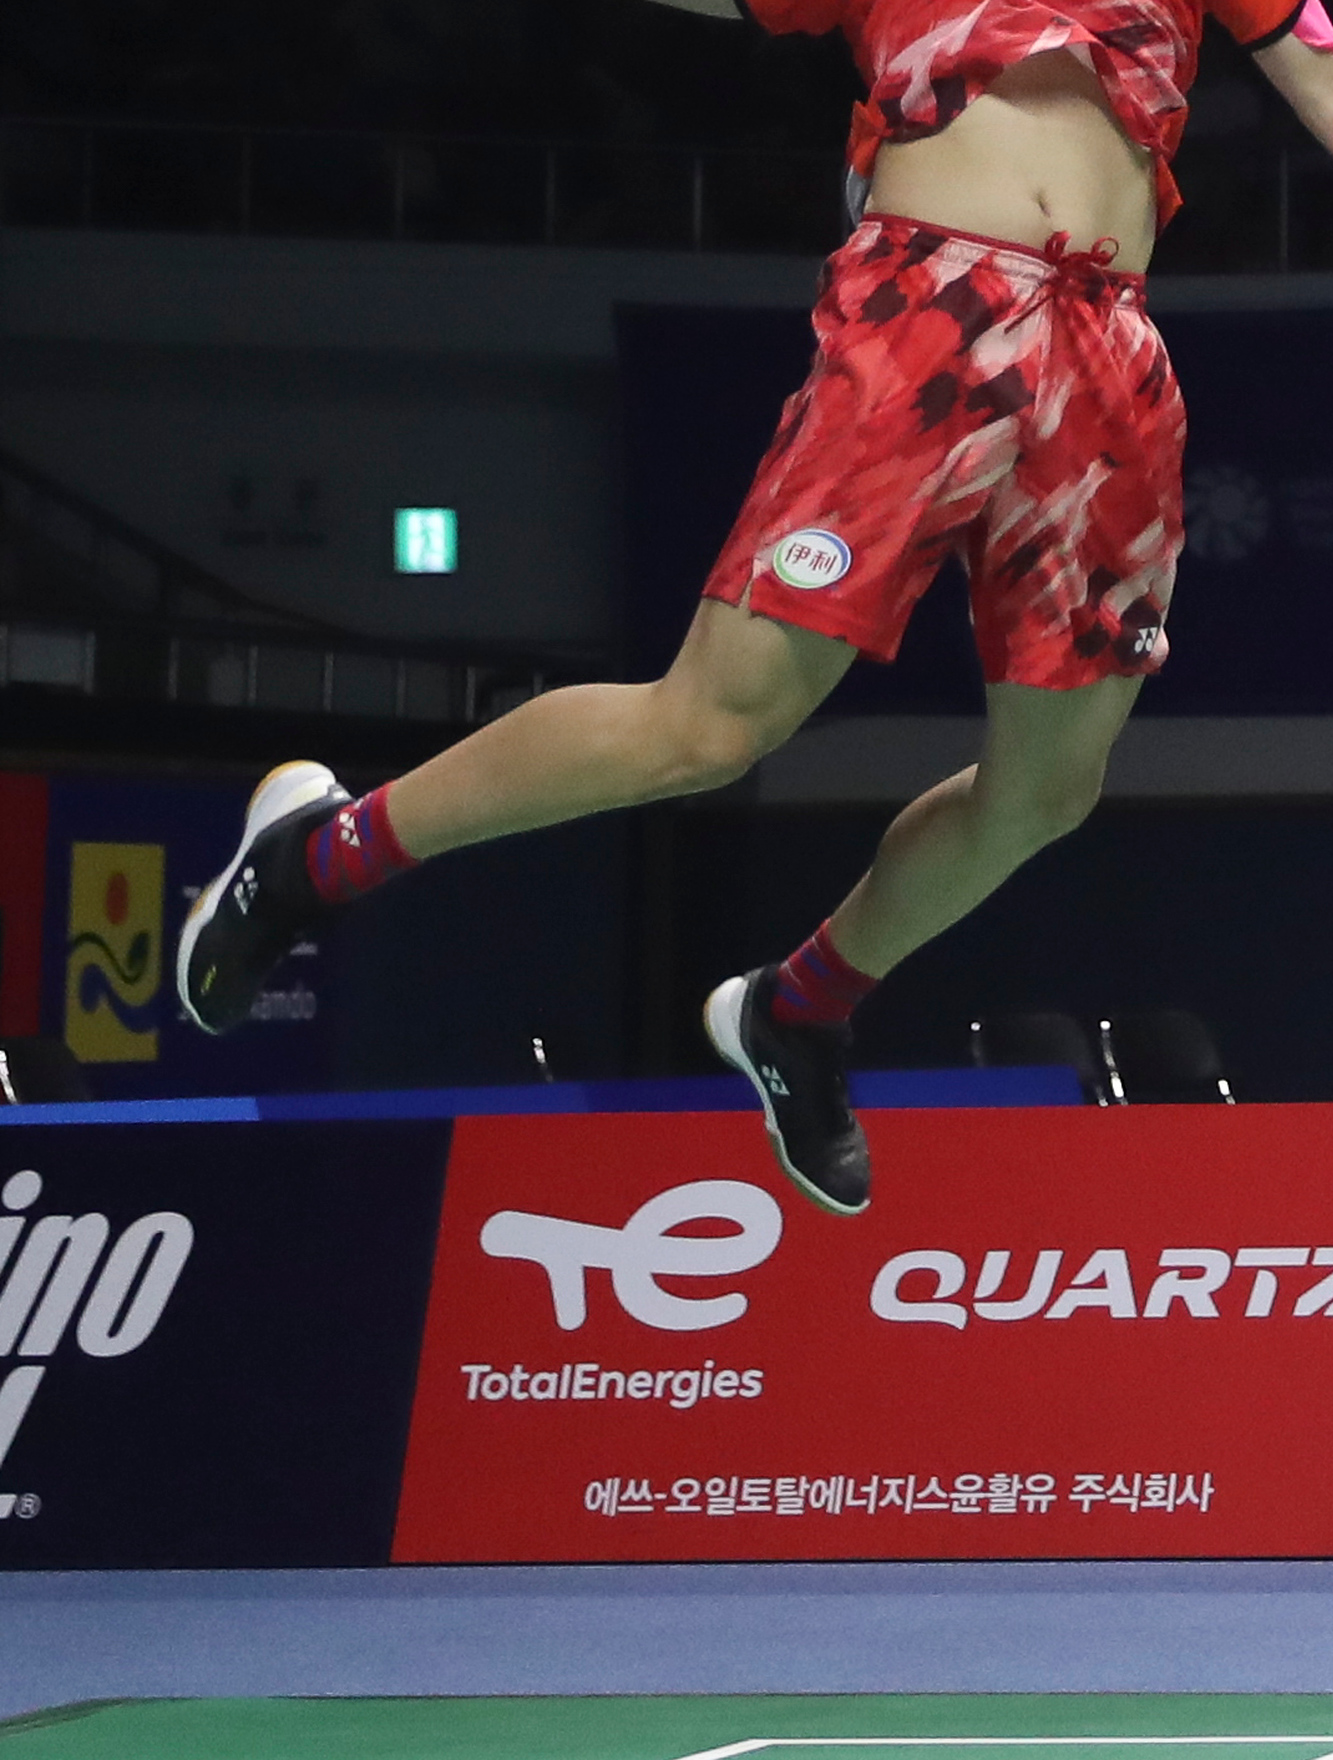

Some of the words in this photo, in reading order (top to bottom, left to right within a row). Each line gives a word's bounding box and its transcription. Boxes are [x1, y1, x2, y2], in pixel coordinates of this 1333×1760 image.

[784, 541, 838, 575] 伊利
[461, 1360, 764, 1408] TotalEnergies
[584, 1472, 1058, 1517] 에쓰-오일토탈에너지스윤활유
[1068, 1472, 1215, 1513] 주식회사
